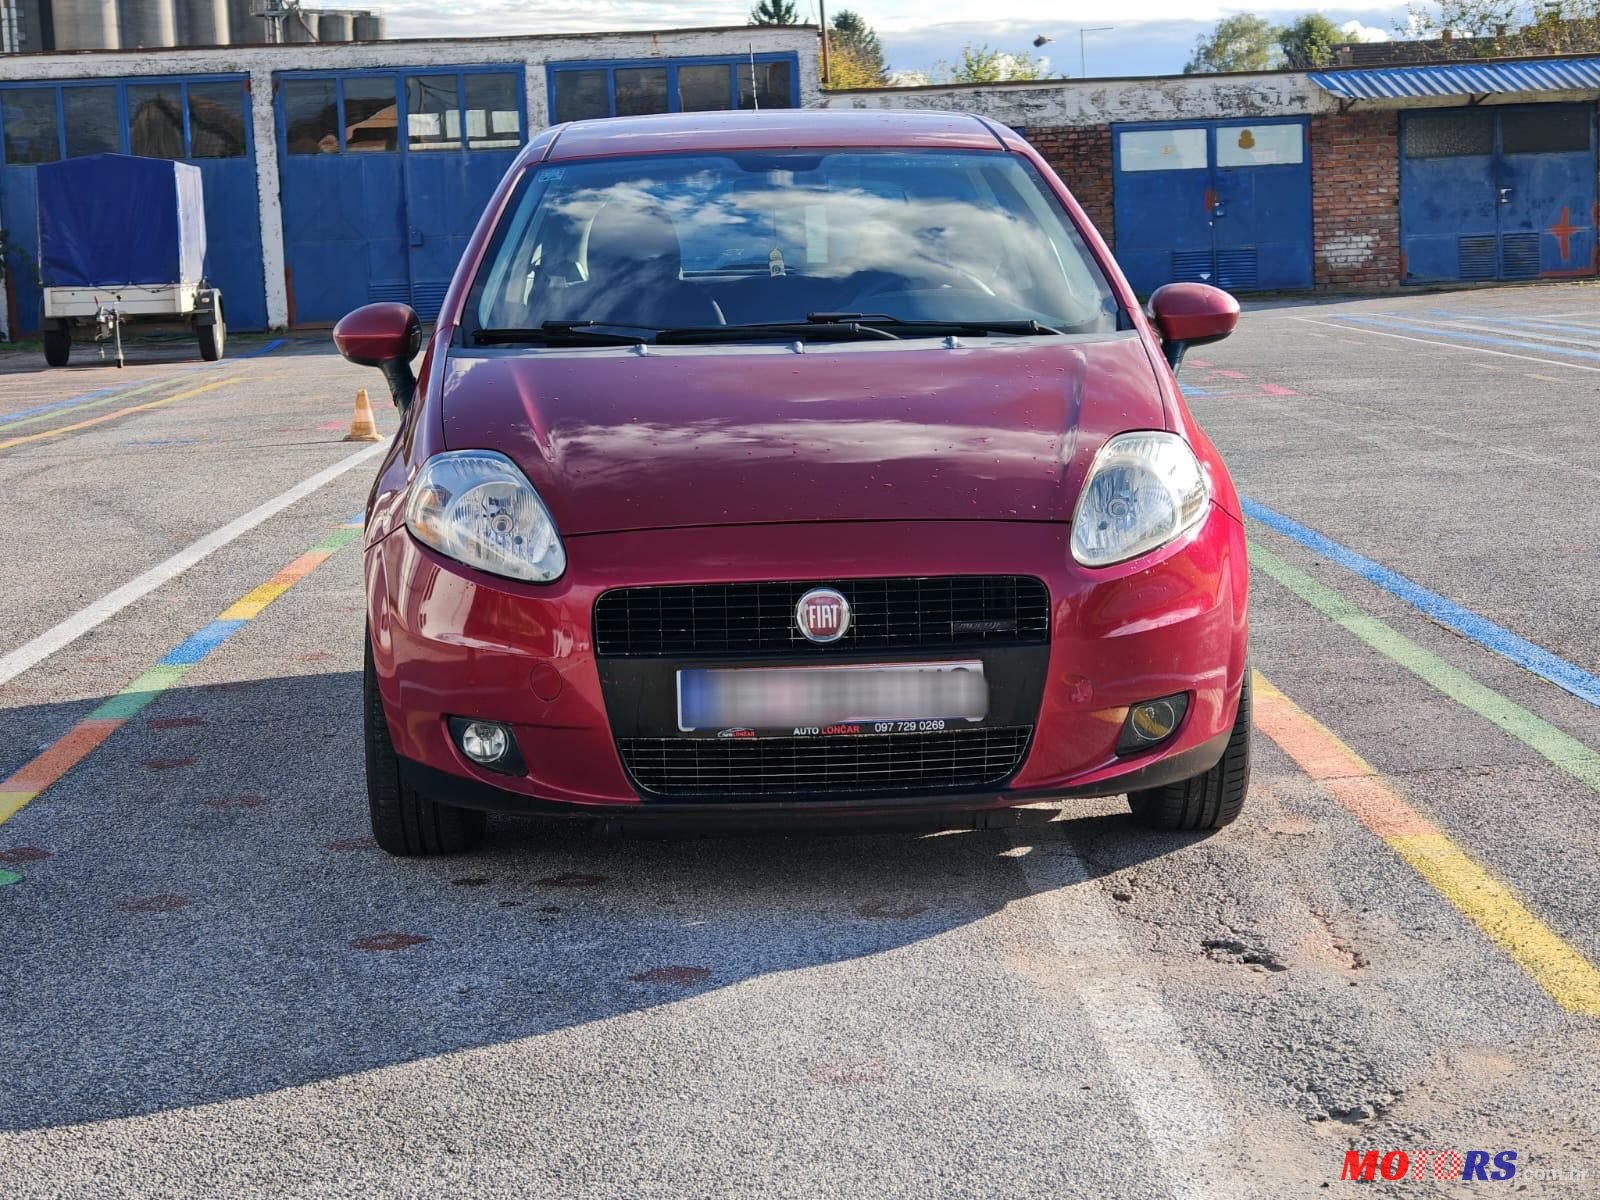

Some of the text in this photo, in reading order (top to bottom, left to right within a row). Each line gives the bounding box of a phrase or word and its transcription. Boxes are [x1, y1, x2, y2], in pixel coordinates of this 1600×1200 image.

[809, 604, 839, 629] FIAT
[793, 727, 819, 736] AUTO
[874, 721, 894, 733] 097
[897, 720, 916, 731] 729
[919, 719, 945, 731] 0269
